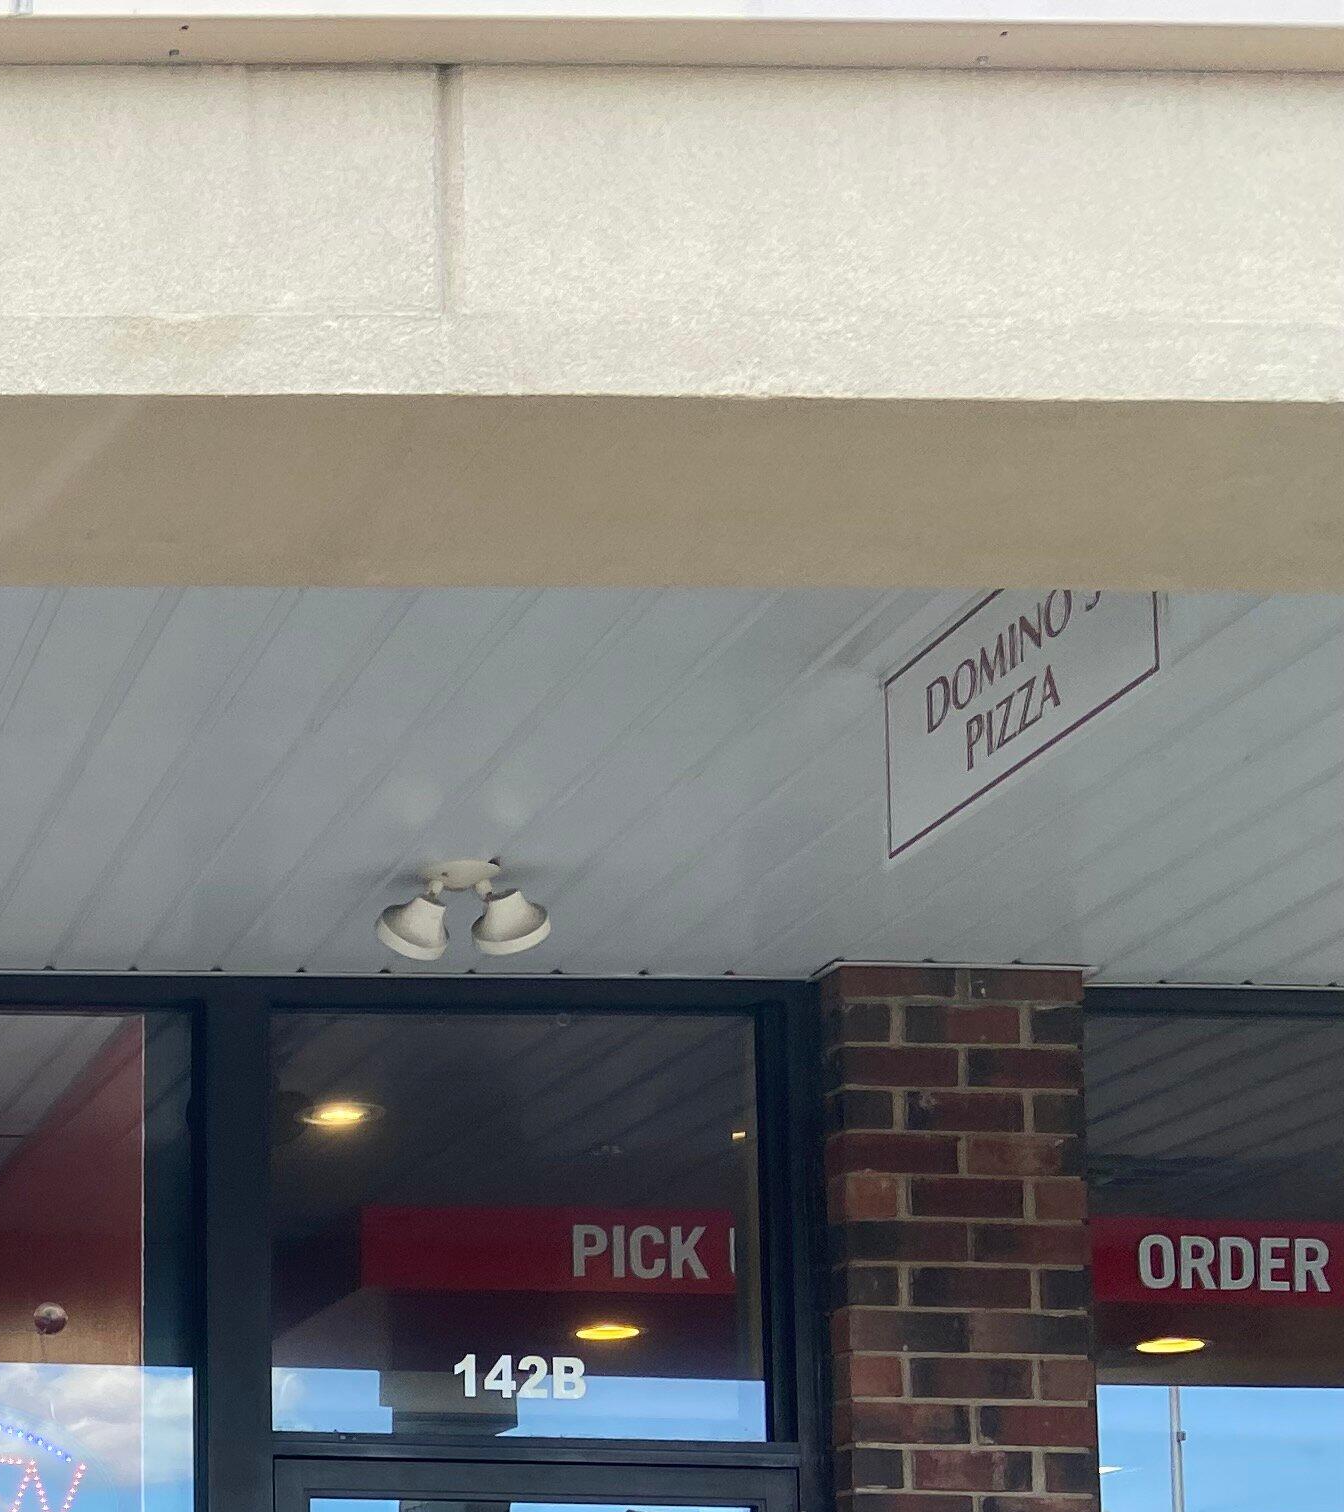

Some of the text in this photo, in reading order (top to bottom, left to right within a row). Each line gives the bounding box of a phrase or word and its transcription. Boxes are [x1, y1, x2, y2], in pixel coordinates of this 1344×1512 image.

[926, 589, 1101, 733] DOMINO
[966, 664, 1061, 771] PIZZA
[572, 1223, 709, 1280] PICK
[1138, 1234, 1331, 1293] ORDER
[453, 1353, 587, 1400] 142B
